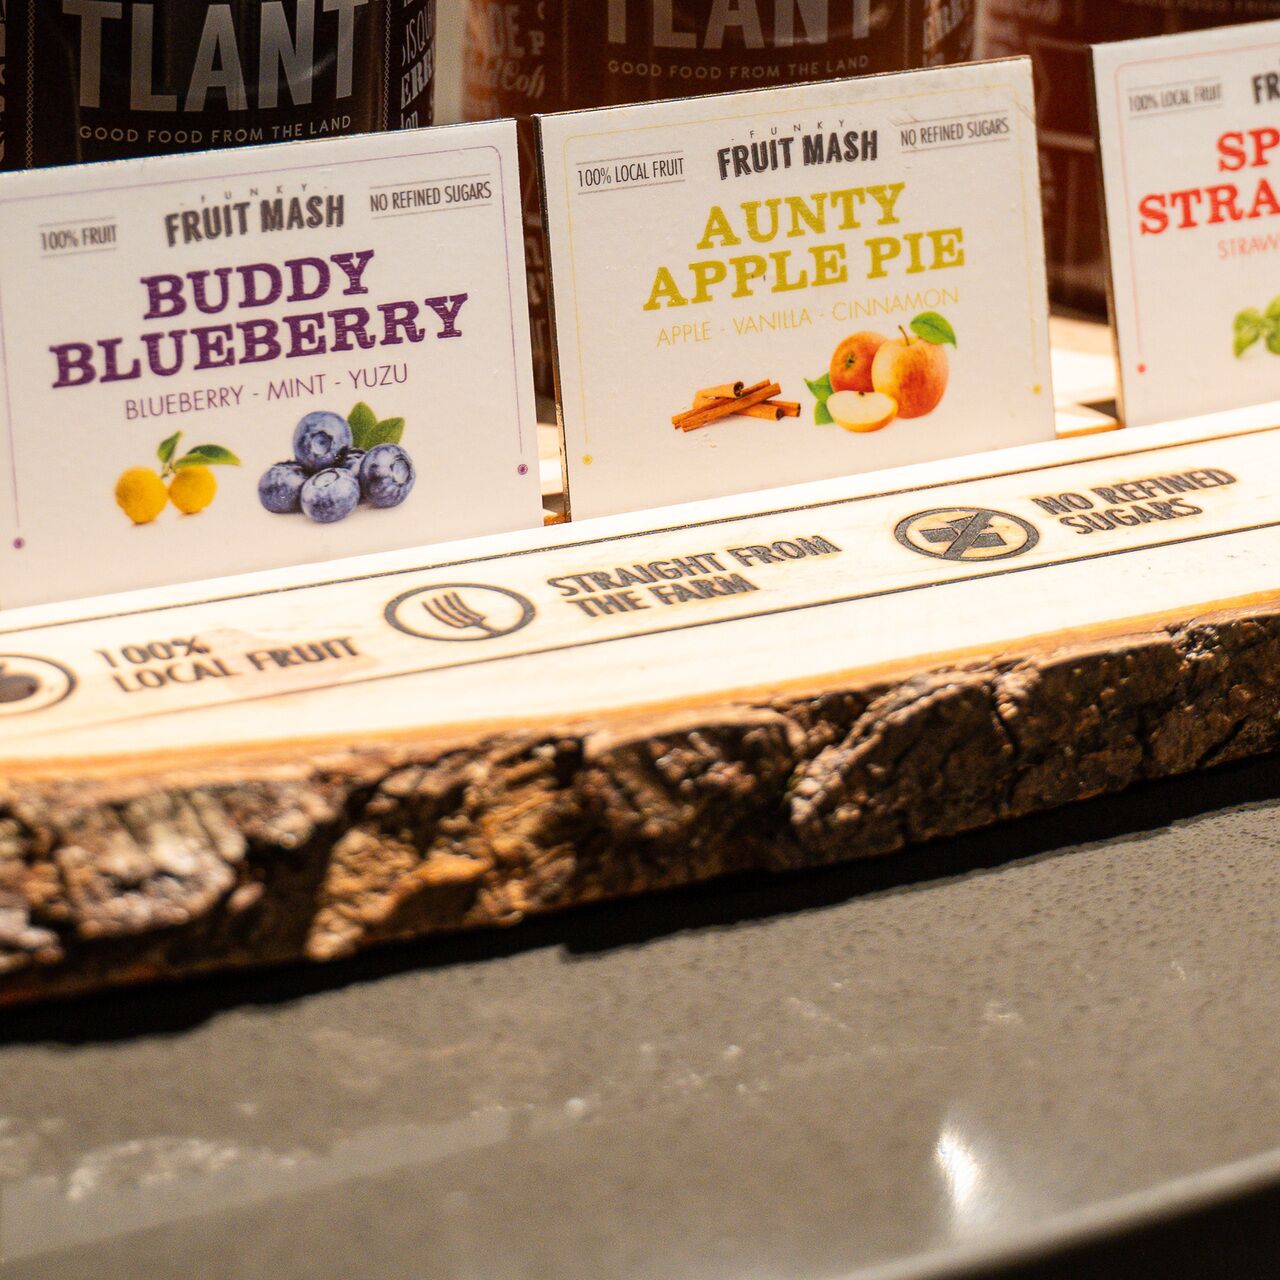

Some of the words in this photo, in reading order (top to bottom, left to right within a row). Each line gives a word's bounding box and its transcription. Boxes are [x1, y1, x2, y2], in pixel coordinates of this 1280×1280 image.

[608, 59, 663, 78] GOOD
[669, 61, 722, 79] FOOD
[729, 61, 780, 79] FROM
[786, 59, 819, 77] THE
[824, 54, 870, 74] LAND
[1160, 87, 1192, 111] LOCAL
[1193, 84, 1223, 107] FRUIT
[80, 124, 139, 144] GOOD
[147, 125, 203, 145] FOOD
[211, 123, 264, 144] FROM
[272, 122, 305, 140] THE
[309, 115, 353, 136] LAND
[716, 136, 796, 182] FRUIT
[803, 128, 880, 168] MASH
[899, 128, 919, 148] NO
[920, 122, 965, 146] REFINED
[966, 116, 1010, 141] SUGARS
[370, 193, 389, 213] NO
[391, 186, 442, 212] REFINED
[444, 180, 493, 205] SUGARS
[577, 165, 613, 189] 100%
[615, 160, 651, 184] LOCAL
[652, 156, 685, 179] FRUIT
[40, 228, 79, 253] 100%
[82, 224, 119, 248] FRUIT
[164, 202, 251, 248] FRUIT
[259, 193, 345, 234] MASH
[696, 181, 905, 251] AUNTY
[140, 248, 375, 321] BUDDY
[642, 243, 849, 312] APPLE
[864, 226, 966, 278] PIE
[48, 291, 470, 390] BLUEBERRY
[656, 323, 712, 349] APPLE
[732, 308, 813, 337] VANILLA
[831, 286, 961, 323] CINNAMON
[124, 384, 245, 421] BLUEBERRY
[265, 373, 328, 403] MINT
[348, 363, 409, 391] YUZU
[1031, 490, 1094, 520] NO
[1096, 467, 1238, 507] REFINED
[1057, 497, 1206, 537] SUGARS
[545, 550, 724, 600] STRAIGHT
[725, 534, 843, 570] FROM
[567, 588, 652, 620] THE
[653, 571, 762, 607] FARM
[94, 634, 210, 670] 100%
[114, 654, 239, 695] LOCAL
[244, 635, 364, 677] FRUIT
